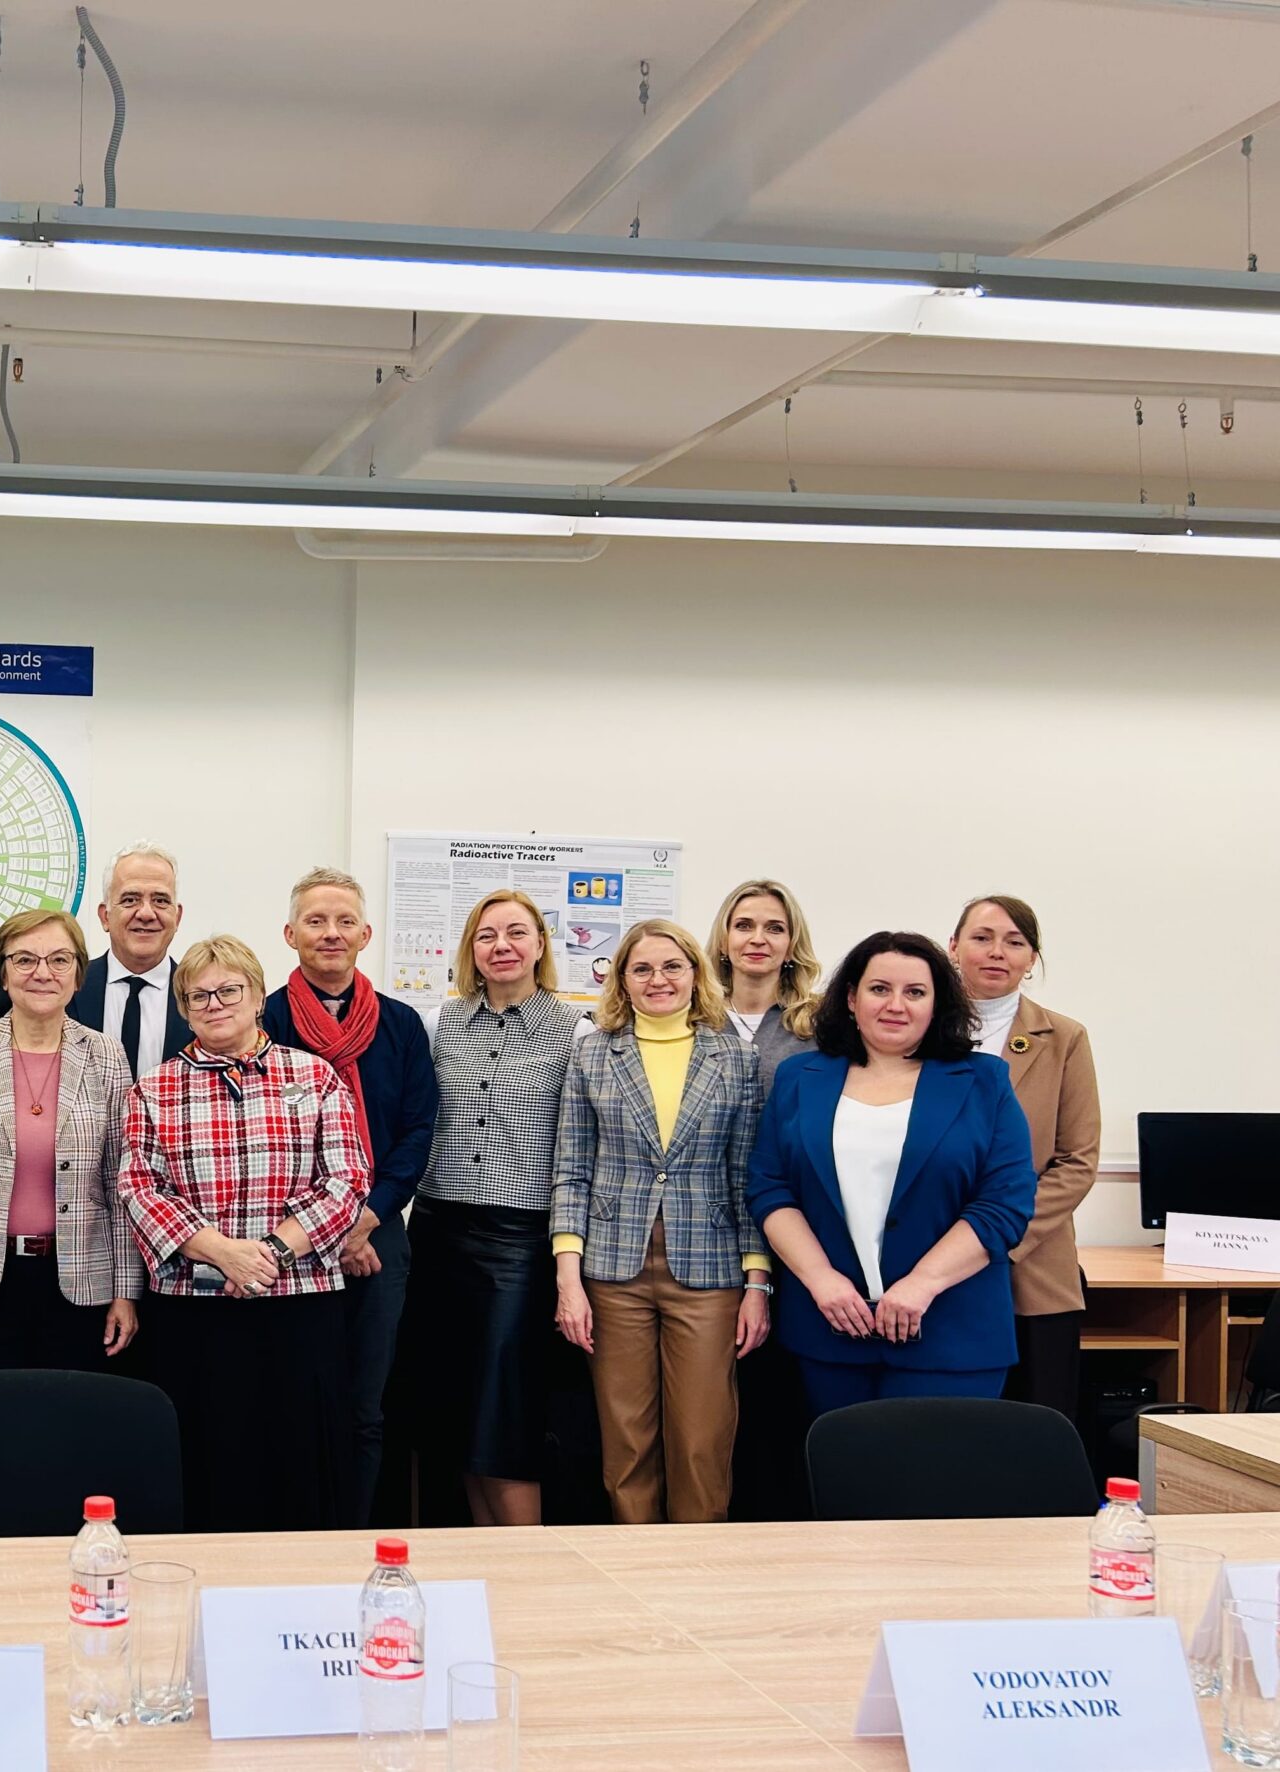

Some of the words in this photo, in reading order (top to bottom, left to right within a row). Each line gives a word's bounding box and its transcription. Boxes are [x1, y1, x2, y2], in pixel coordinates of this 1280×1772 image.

[450, 849, 514, 860] Radioactive
[517, 851, 556, 861] Tracers
[278, 1631, 357, 1650] TKACH
[322, 1659, 359, 1677] IRI
[972, 1669, 1113, 1689] VODOVATOV
[982, 1699, 1123, 1720] ALEKSANDR
